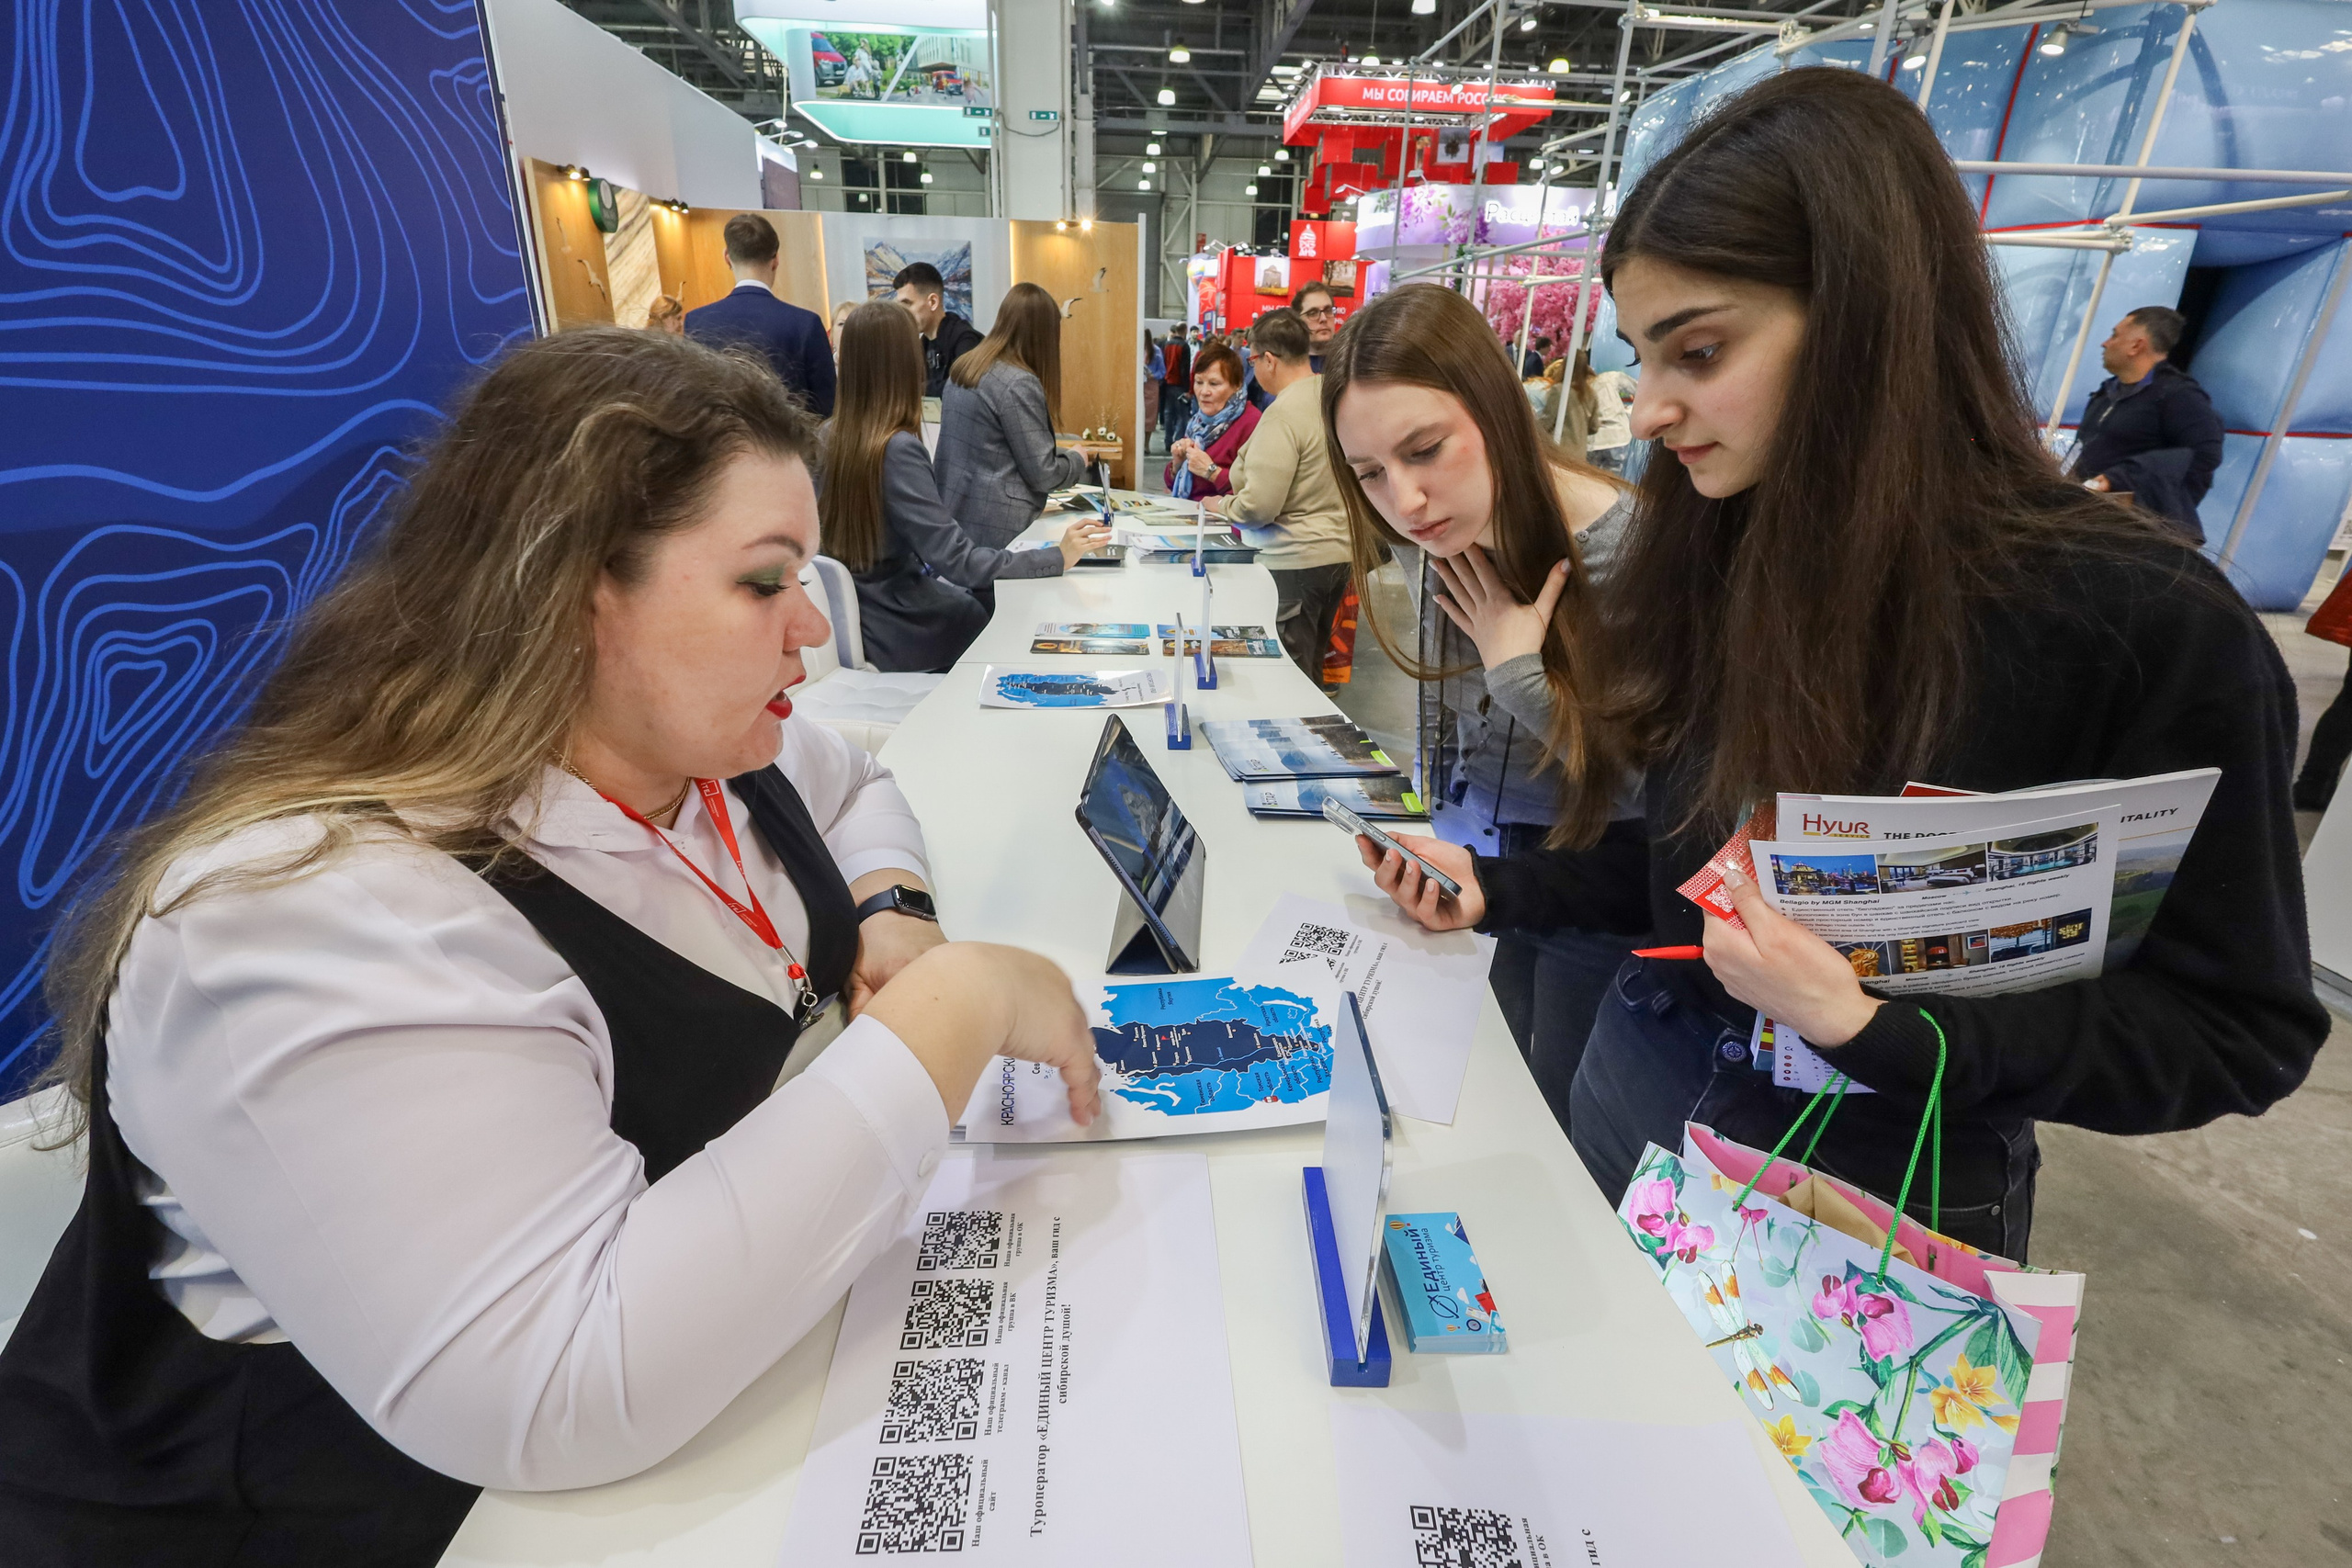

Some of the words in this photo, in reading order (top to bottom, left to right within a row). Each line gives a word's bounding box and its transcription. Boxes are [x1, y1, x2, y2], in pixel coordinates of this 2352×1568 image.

[1363, 87, 1384, 100] МЫ
[1457, 93, 1506, 106] РОСС
[2120, 807, 2179, 823] ITALITY
[2048, 874, 2070, 882] weekly
[1270, 1007, 1279, 1023] область
[1254, 1072, 1264, 1092] Томская
[1264, 1071, 1274, 1091] область
[1291, 1065, 1301, 1085] область
[1206, 1081, 1216, 1102] область
[1006, 1213, 1016, 1248] официальная
[1017, 1222, 1023, 1232] ОК
[1052, 1223, 1061, 1237] гид
[1051, 1240, 1059, 1258] ваш
[1421, 1227, 1441, 1263] туризма
[1402, 1228, 1440, 1292] ЕДИНЫЙ
[1435, 1264, 1451, 1292] центр
[998, 1281, 1009, 1325] официальная
[1010, 1292, 1017, 1303] ВК
[1045, 1261, 1059, 1324] ТУРИЗМА»,
[1008, 1309, 1016, 1332] группа
[1060, 1303, 1072, 1342] душой!
[995, 1325, 1003, 1345] Наша
[1041, 1325, 1055, 1370] ЦЕНТР
[1057, 1345, 1070, 1404] сибирской
[987, 1362, 1000, 1416] официальный
[997, 1392, 1007, 1434] телеграмм
[1036, 1371, 1052, 1441] «ЕДИНЫЙ
[984, 1416, 994, 1436] Наш
[976, 1459, 989, 1524] официальный
[989, 1491, 997, 1512] сайт
[1030, 1444, 1050, 1538] Туроператор
[972, 1524, 981, 1547] Наш
[1521, 1517, 1540, 1568] ициальная
[1535, 1535, 1546, 1551] ОК
[1585, 1540, 1600, 1566] гид
